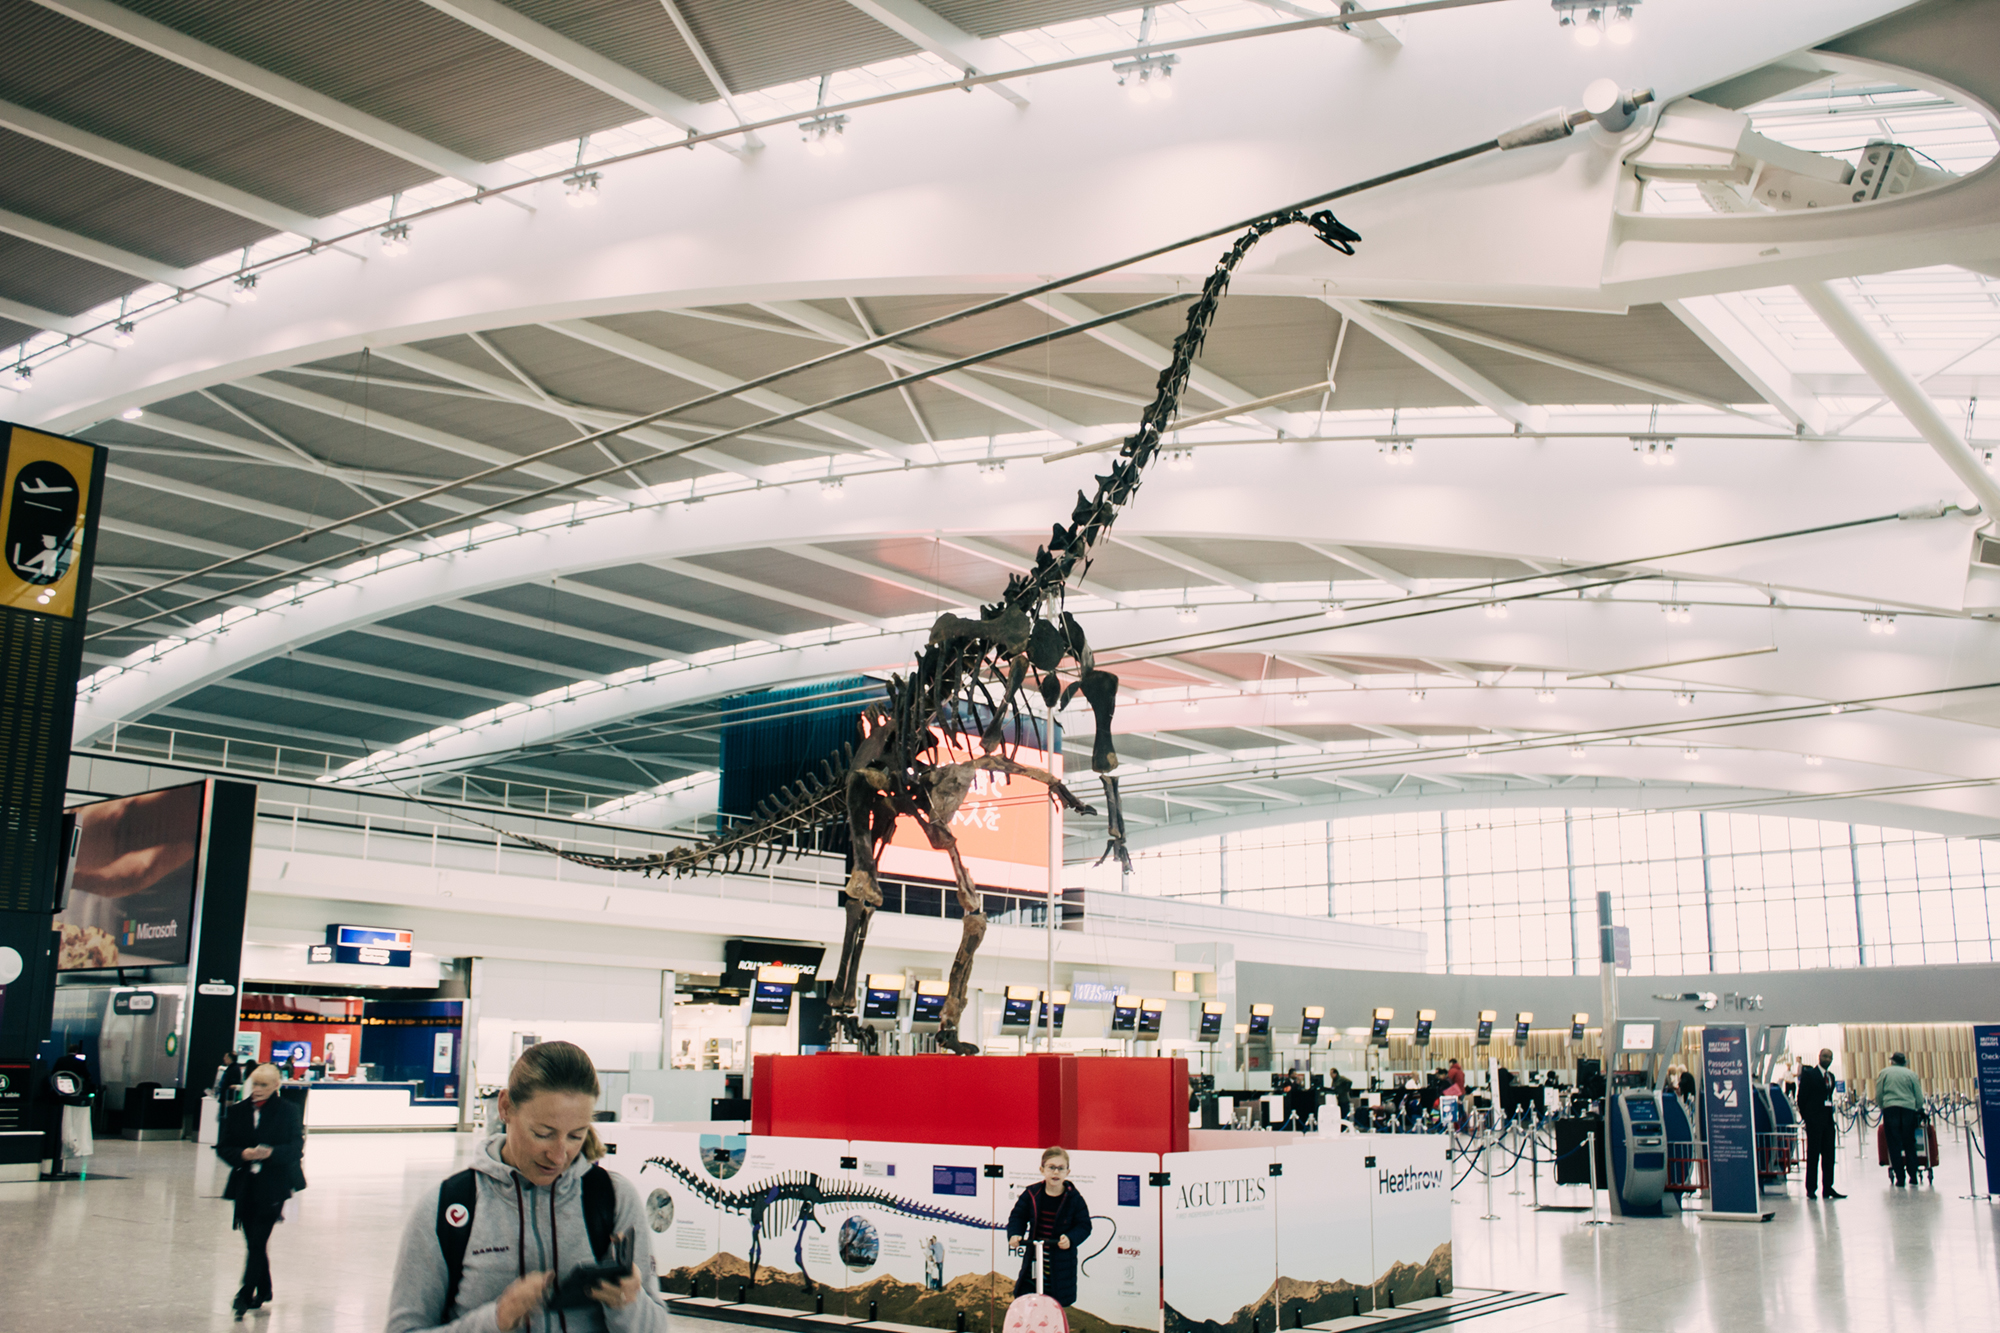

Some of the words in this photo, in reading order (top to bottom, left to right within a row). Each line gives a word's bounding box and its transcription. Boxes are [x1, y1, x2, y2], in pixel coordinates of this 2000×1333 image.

[136, 919, 178, 941] Microsoft
[1073, 982, 1126, 1004] WHSmith
[1724, 991, 1764, 1011] First
[1708, 1060, 1736, 1068] Passport
[1736, 1059, 1743, 1067] &
[1722, 1068, 1743, 1076] Check
[1378, 1165, 1443, 1195] Heathrow
[1176, 1177, 1267, 1210] AGUTTES
[472, 1246, 509, 1254] MAMMUT
[1124, 1246, 1141, 1258] edge
